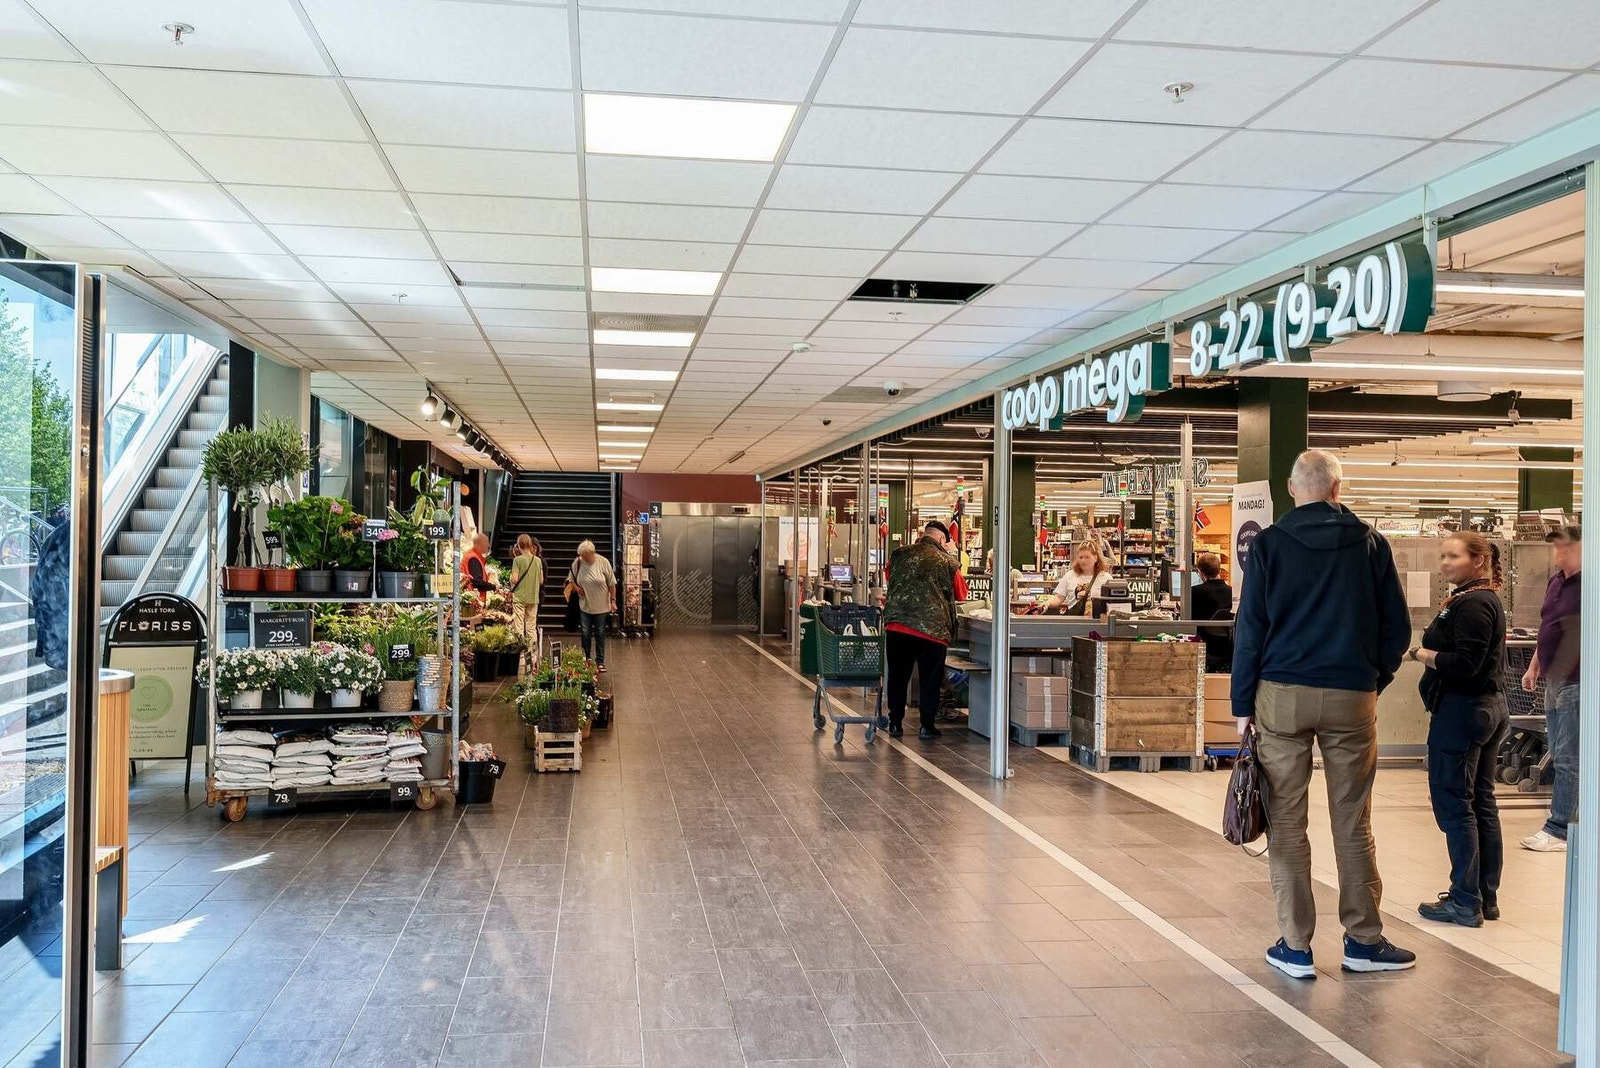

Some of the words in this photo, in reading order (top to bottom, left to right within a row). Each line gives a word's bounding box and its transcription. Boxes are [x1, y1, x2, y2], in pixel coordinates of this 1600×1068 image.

[1190, 301, 1264, 377] 8-22
[1273, 242, 1408, 363] (9-20)
[1002, 376, 1060, 432] coop
[1063, 341, 1152, 423] mega
[652, 505, 659, 514] 3
[1238, 499, 1265, 511] MANDAG!
[1129, 511, 1135, 520] 3
